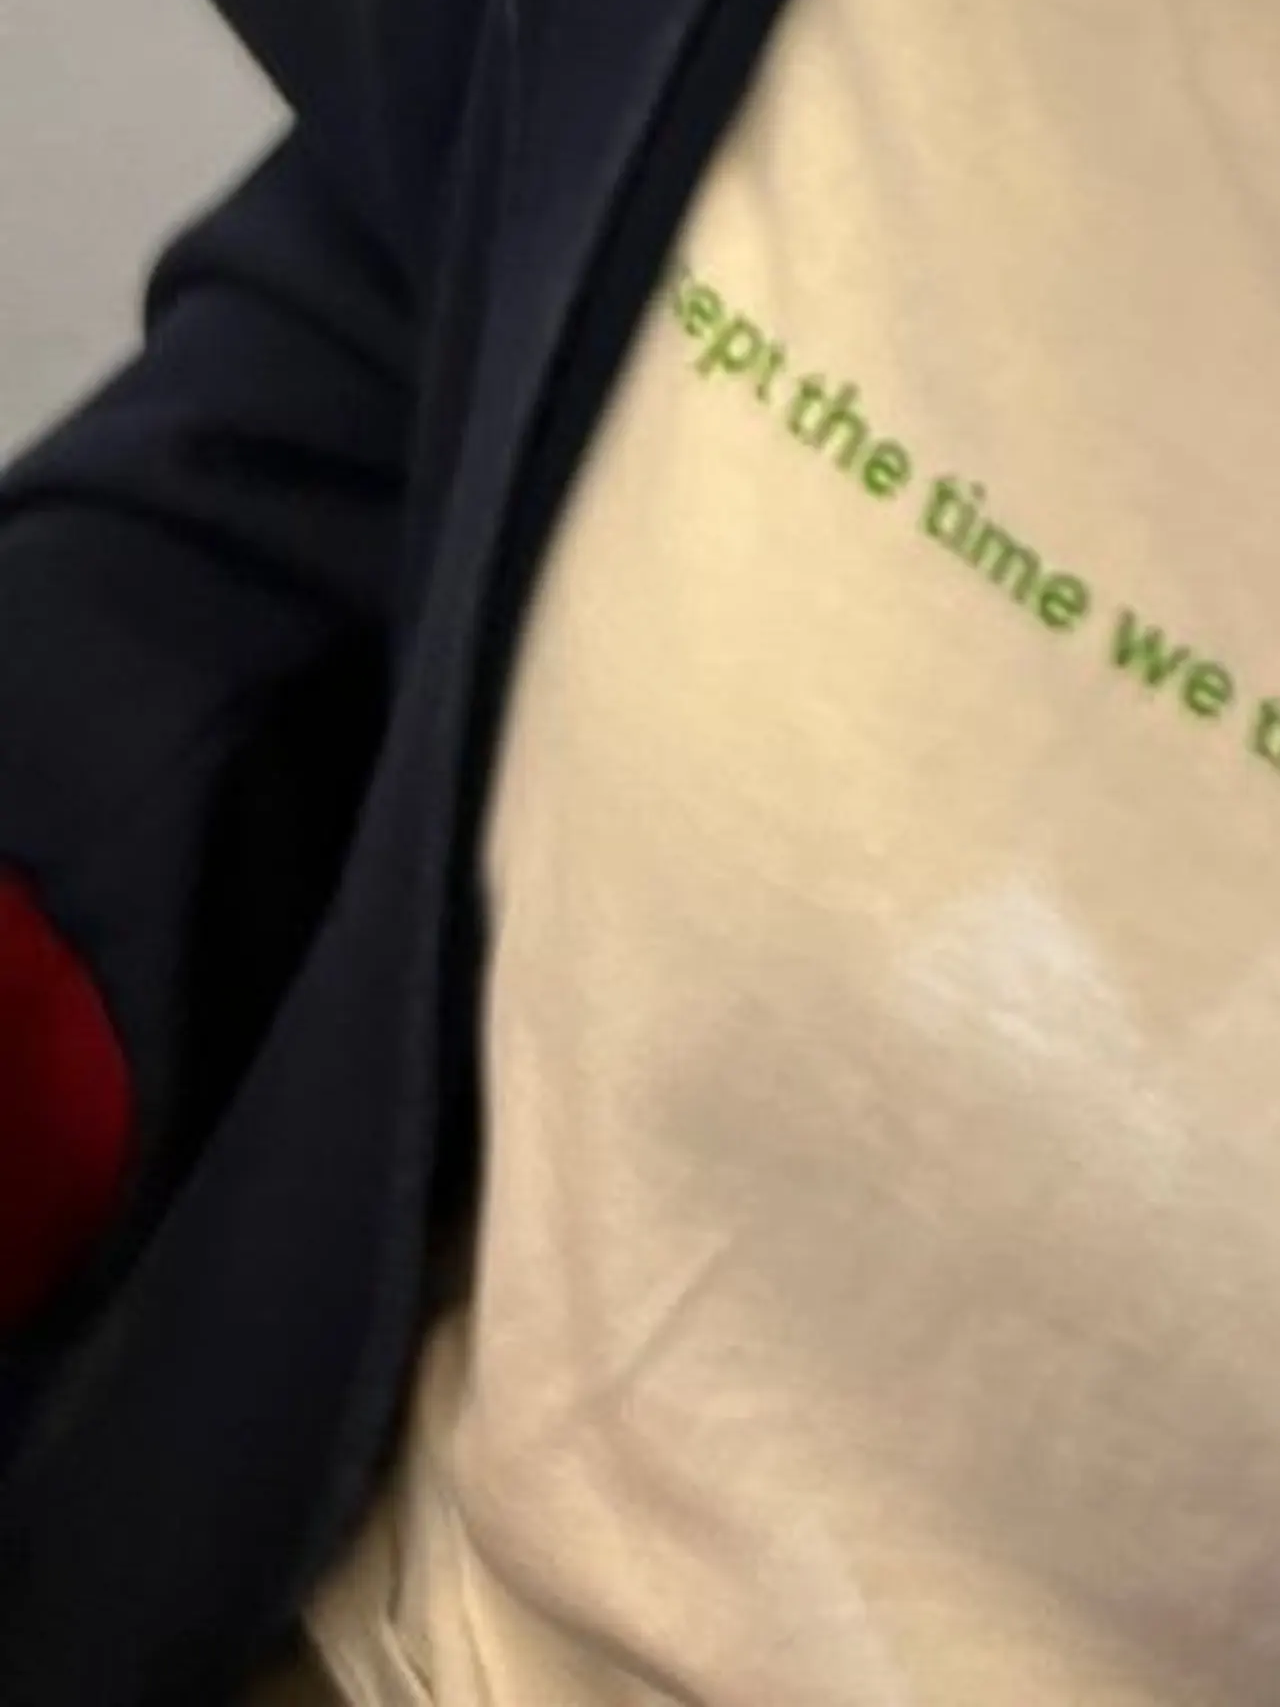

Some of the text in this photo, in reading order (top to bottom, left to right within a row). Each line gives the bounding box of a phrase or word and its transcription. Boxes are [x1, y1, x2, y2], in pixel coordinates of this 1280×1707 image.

[786, 373, 911, 498] the
[920, 477, 1090, 631] time
[1109, 608, 1234, 718] we
